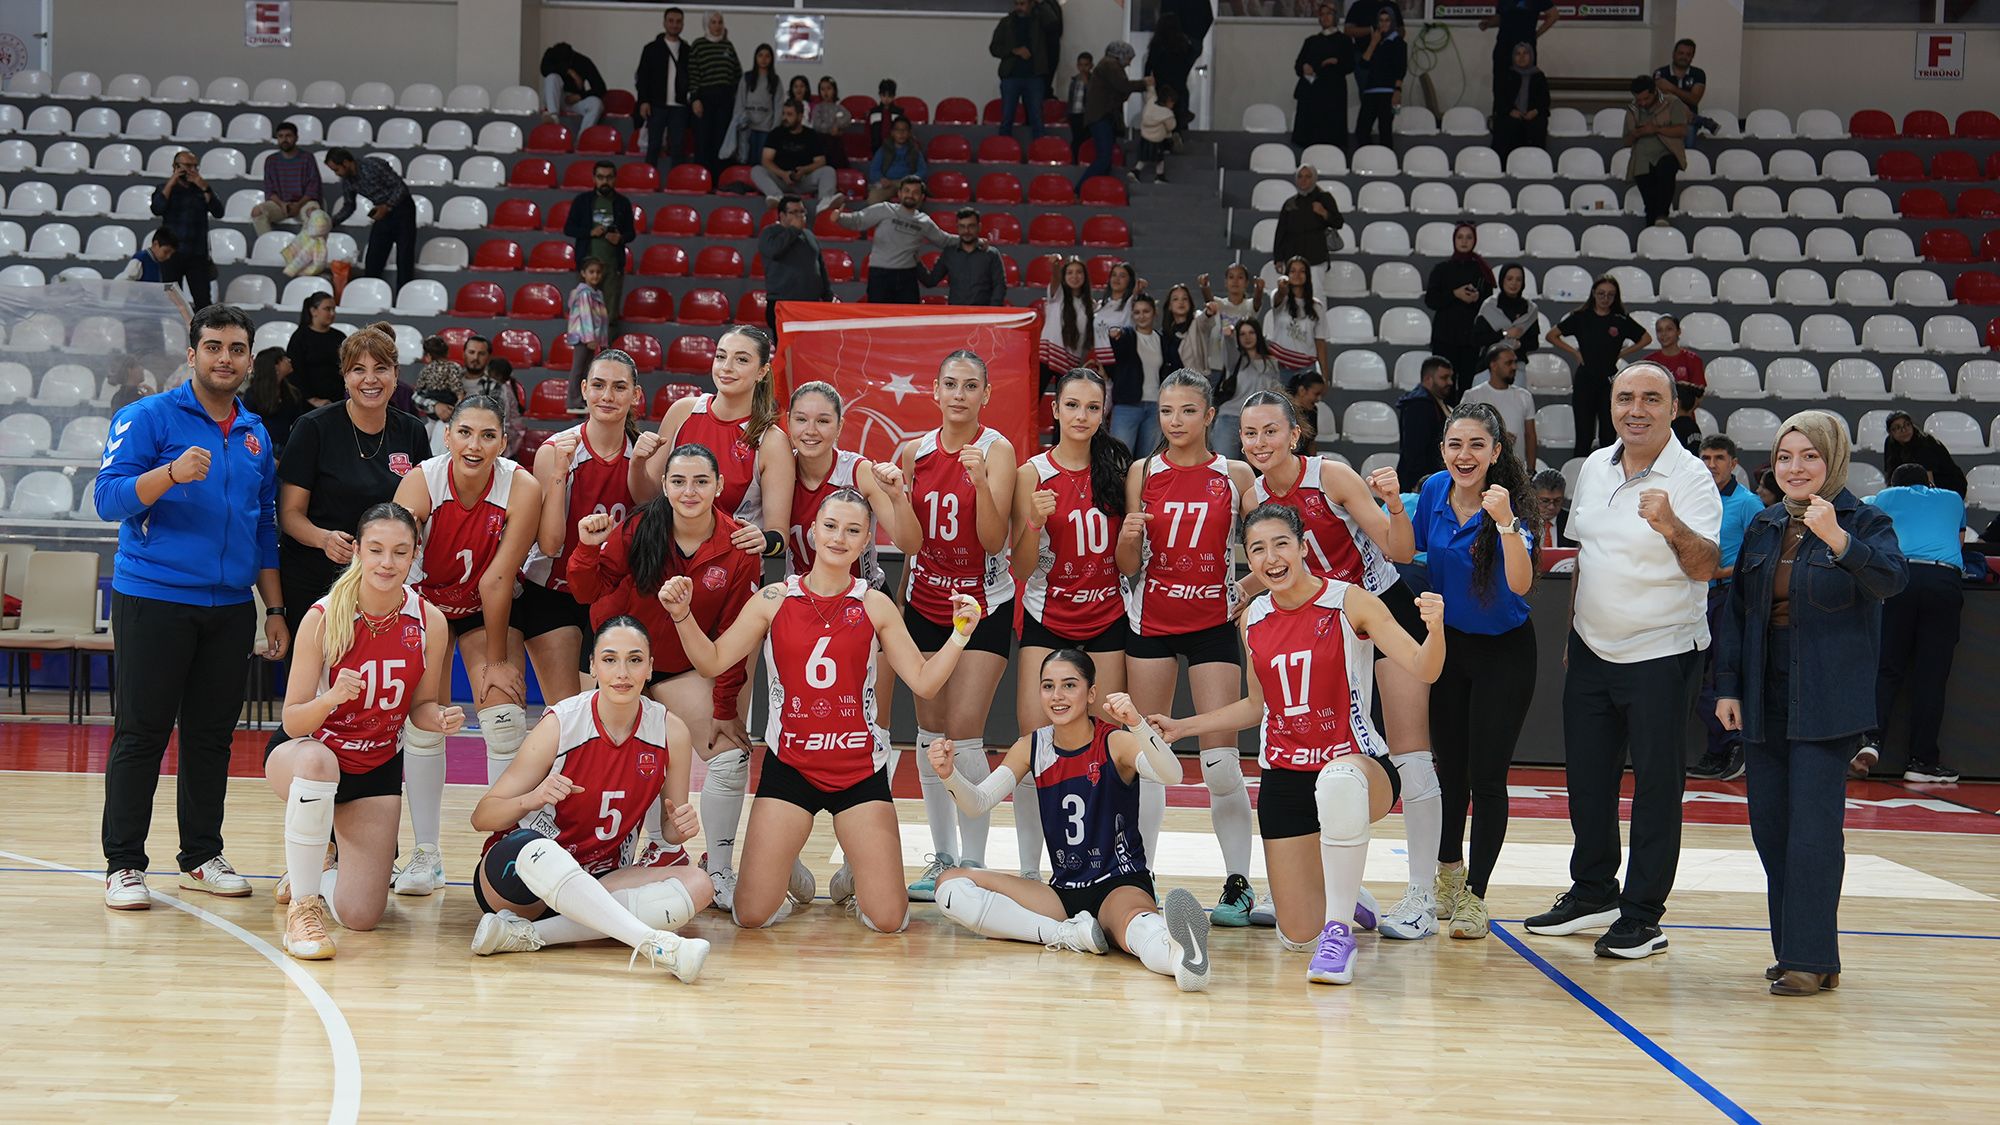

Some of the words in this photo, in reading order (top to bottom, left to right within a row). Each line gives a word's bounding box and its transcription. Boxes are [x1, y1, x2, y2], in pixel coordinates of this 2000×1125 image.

[256, 4, 279, 34] E
[1928, 36, 1952, 67] F
[924, 490, 959, 541] 13
[1163, 501, 1209, 549] 77
[1067, 507, 1109, 557] 10
[456, 549, 473, 584] 1
[1200, 553, 1215, 561] Milk
[1200, 565, 1215, 573] ART
[1148, 578, 1223, 600] T-BIKE
[805, 636, 837, 689] 6
[360, 659, 407, 711] 15
[1270, 649, 1312, 707] 17
[838, 695, 857, 704] Milk
[840, 708, 857, 717] ART
[1316, 707, 1335, 718] Milk
[1320, 720, 1336, 731] ART
[783, 731, 869, 751] T-BIKE
[1269, 741, 1352, 765] T-BIKE
[595, 790, 625, 841] 5
[1061, 793, 1086, 846] 3
